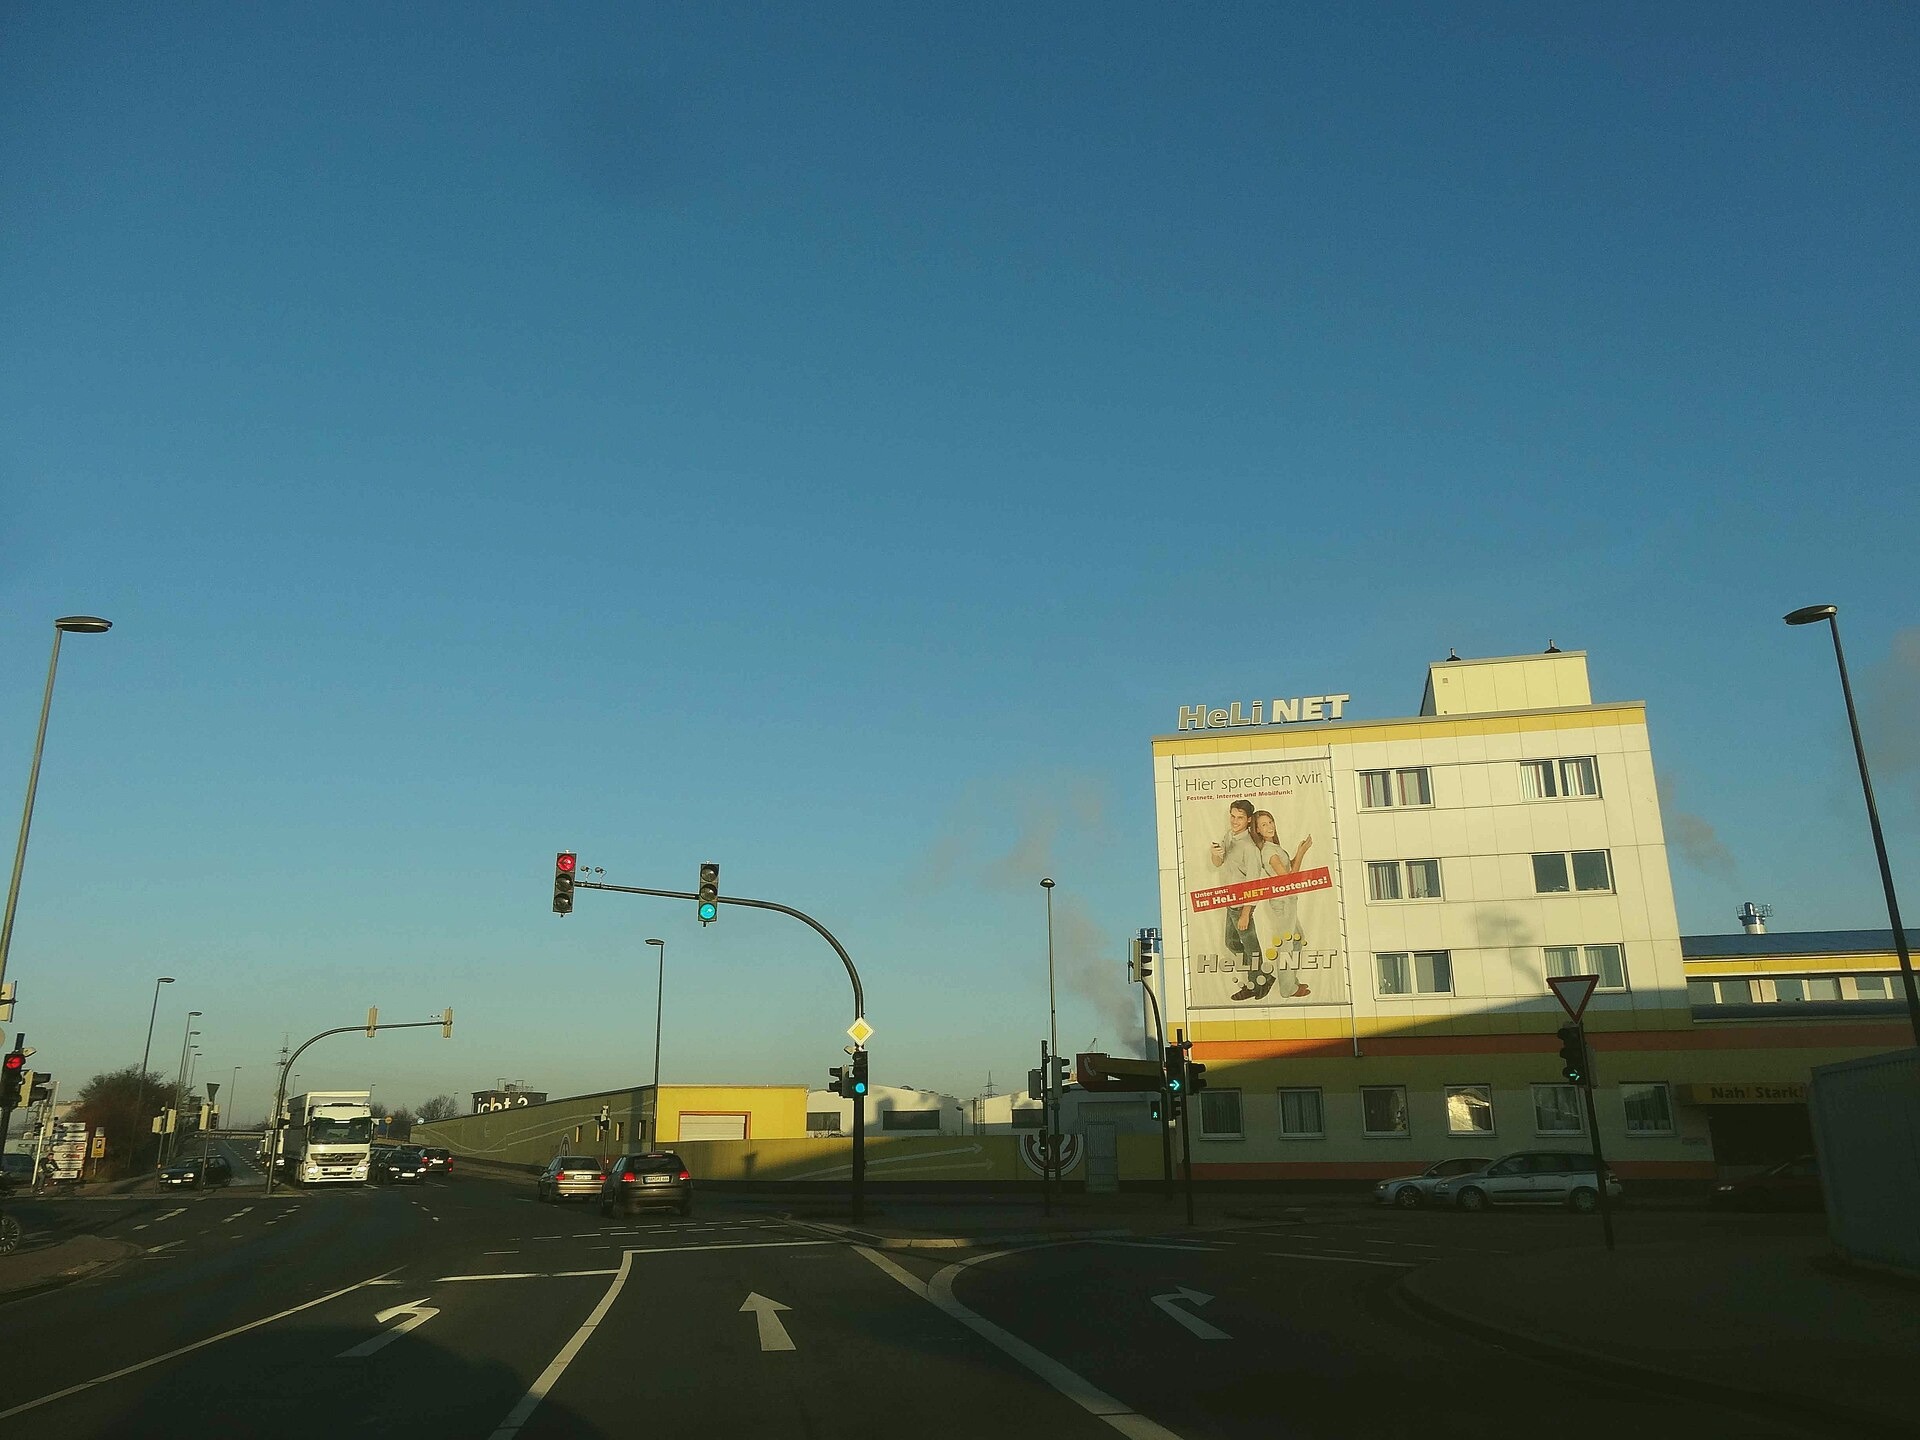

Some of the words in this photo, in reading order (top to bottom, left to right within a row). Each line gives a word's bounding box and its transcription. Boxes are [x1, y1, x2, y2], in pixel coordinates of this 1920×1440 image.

[1178, 701, 1263, 731] HeLi
[1272, 694, 1349, 723] NET
[1185, 778, 1216, 791] Hier
[1221, 774, 1291, 792] sprechen
[1296, 771, 1323, 785] wir.
[1258, 789, 1293, 797] Mobilfunk!
[1194, 891, 1213, 899] Unter
[1195, 899, 1210, 908] Im
[1212, 893, 1237, 905] HeLi
[1271, 876, 1328, 894] kostenlos!
[1197, 950, 1260, 974] HeLi
[1279, 949, 1338, 971] NET
